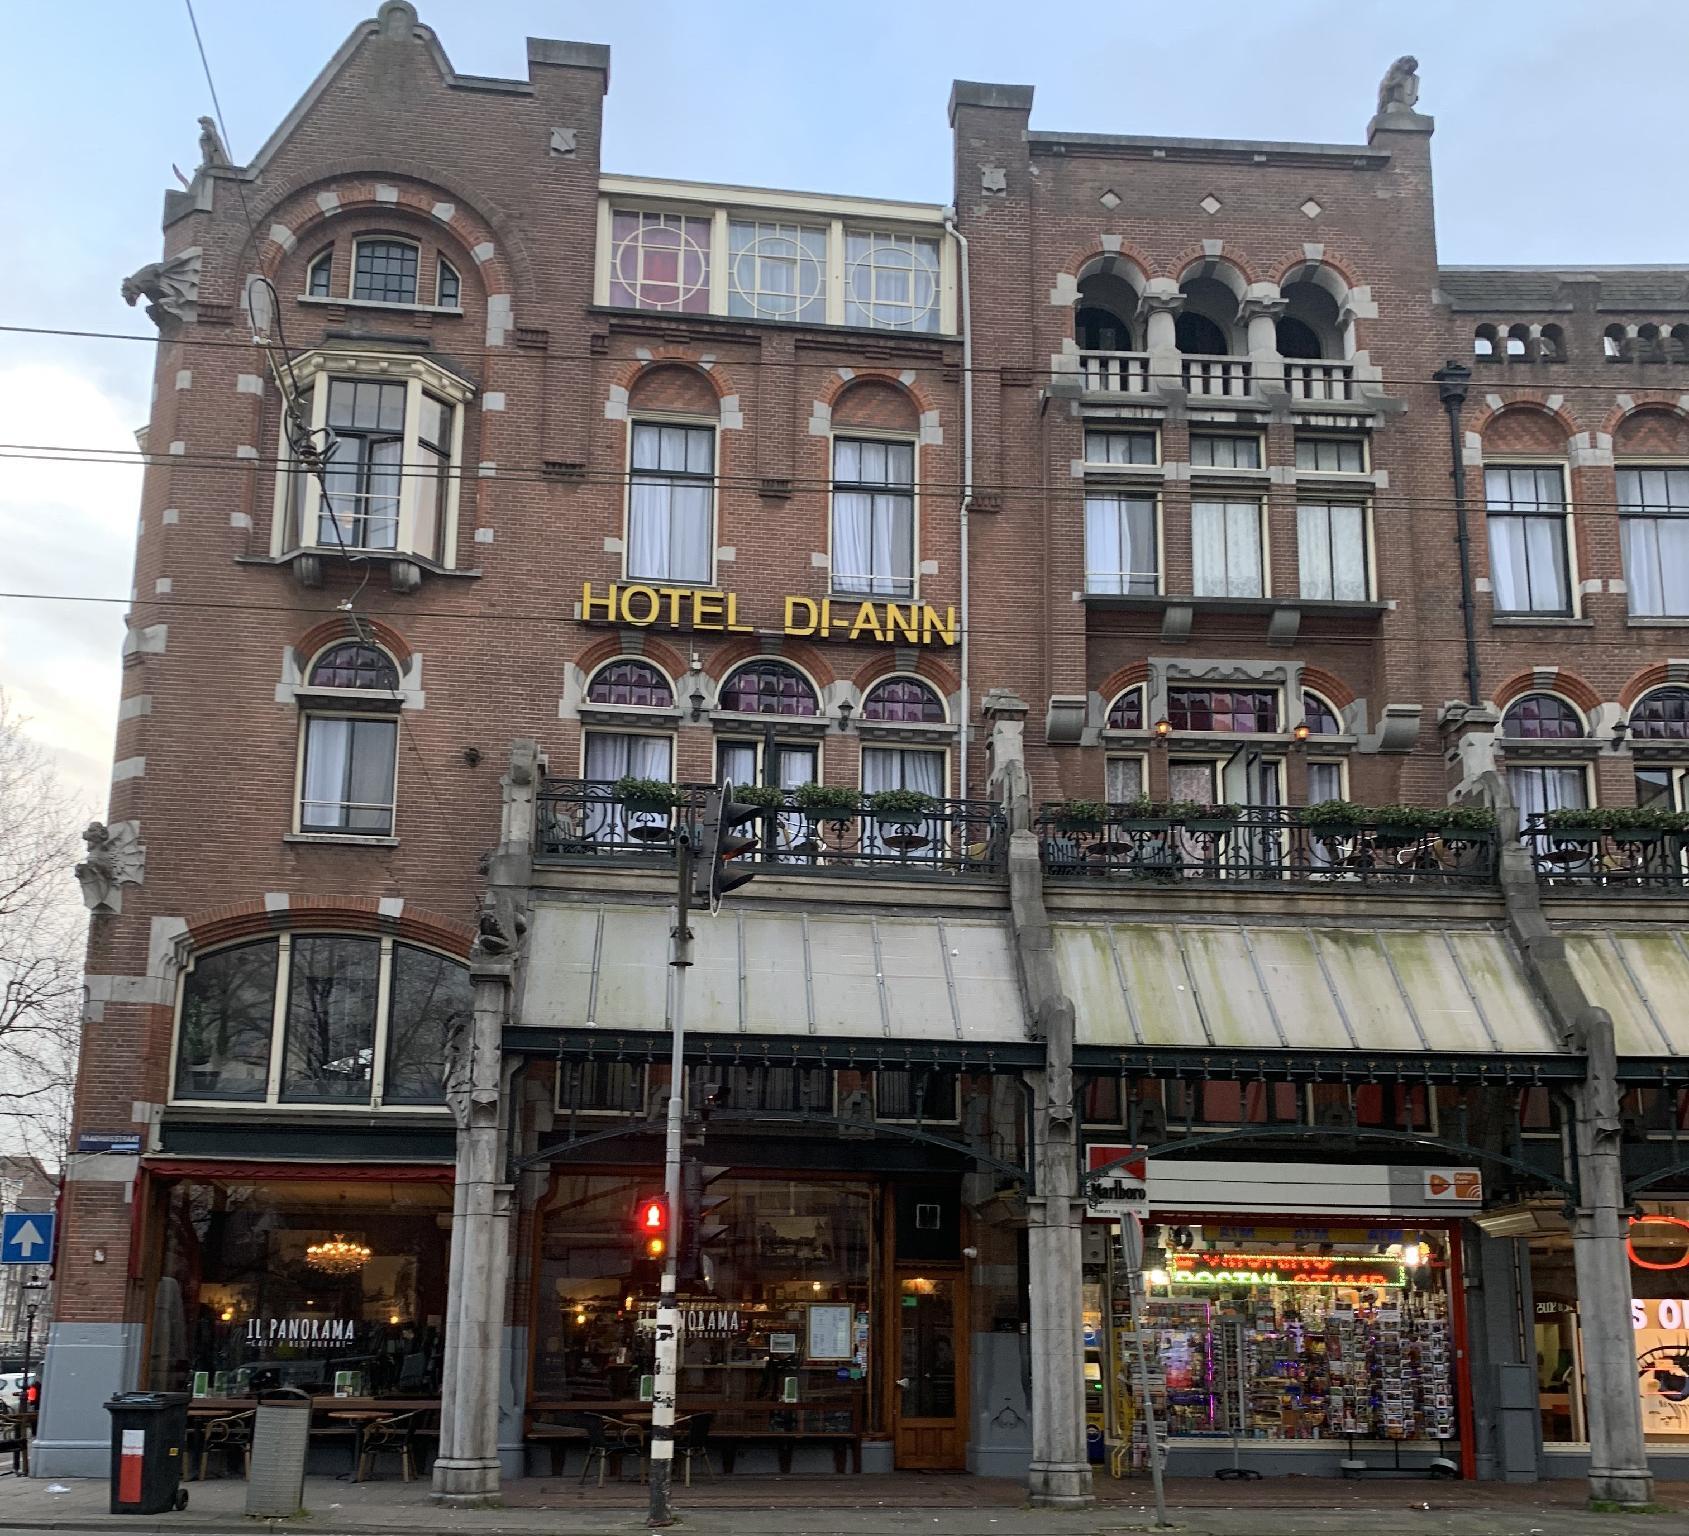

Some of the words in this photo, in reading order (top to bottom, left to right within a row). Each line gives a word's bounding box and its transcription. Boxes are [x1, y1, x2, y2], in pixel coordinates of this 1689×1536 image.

[582, 582, 754, 632] HOTEL
[784, 596, 955, 646] DI-ANN
[1089, 1179, 1147, 1200] Marlboro
[246, 1318, 262, 1339] IL
[269, 1318, 354, 1340] PANORAMA
[288, 1340, 347, 1348] RESTAURANT
